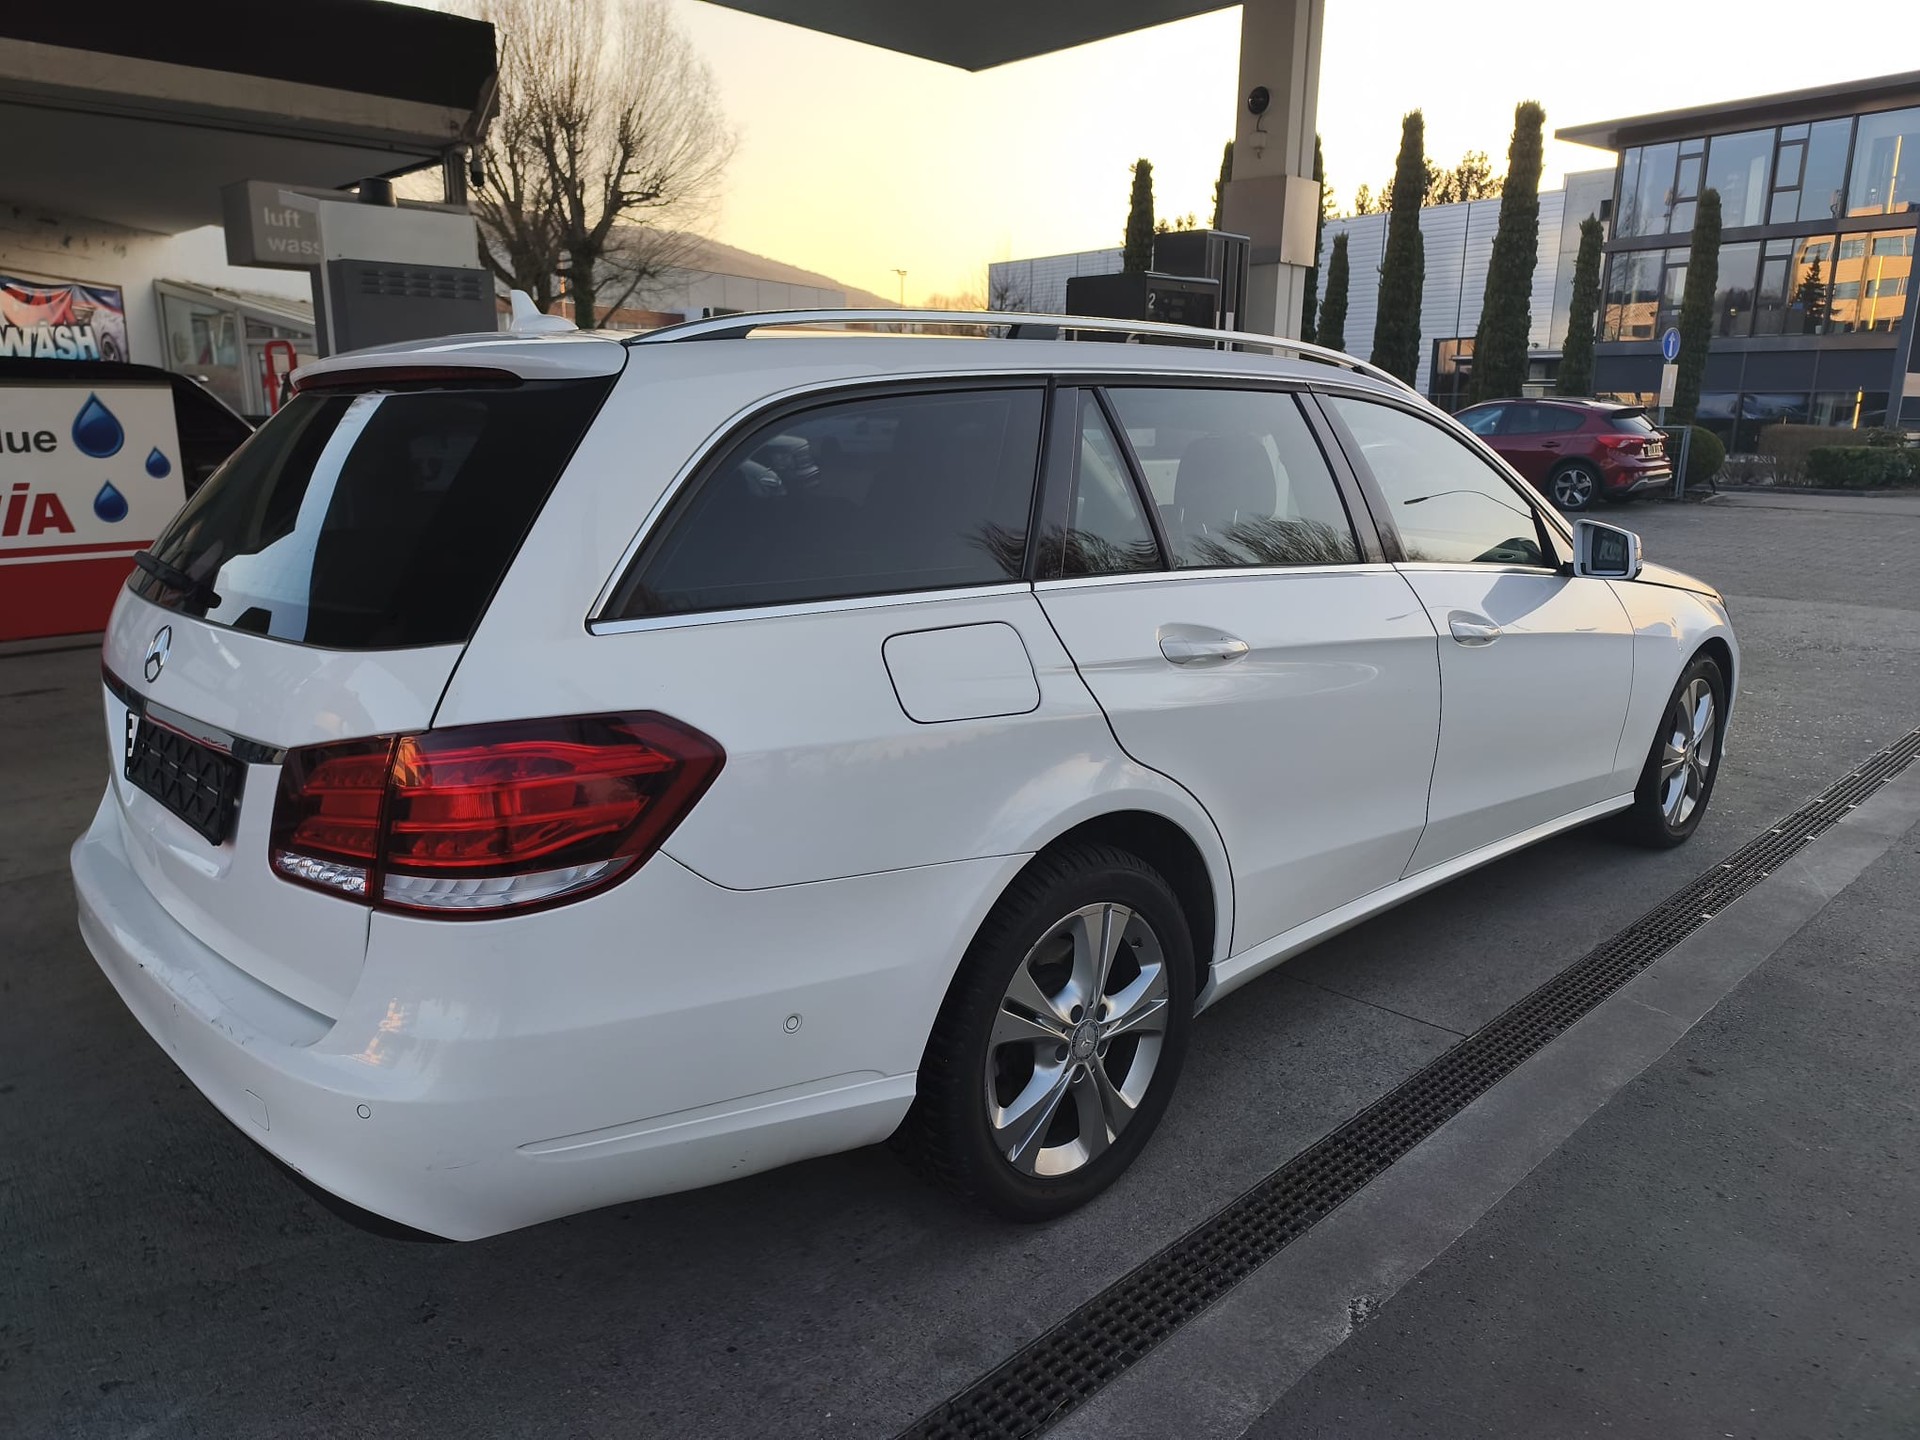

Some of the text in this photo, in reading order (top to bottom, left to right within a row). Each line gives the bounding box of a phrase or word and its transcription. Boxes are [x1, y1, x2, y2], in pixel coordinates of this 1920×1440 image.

[264, 207, 301, 228] luft
[1148, 292, 1156, 309] 2
[0, 325, 100, 360] WASH
